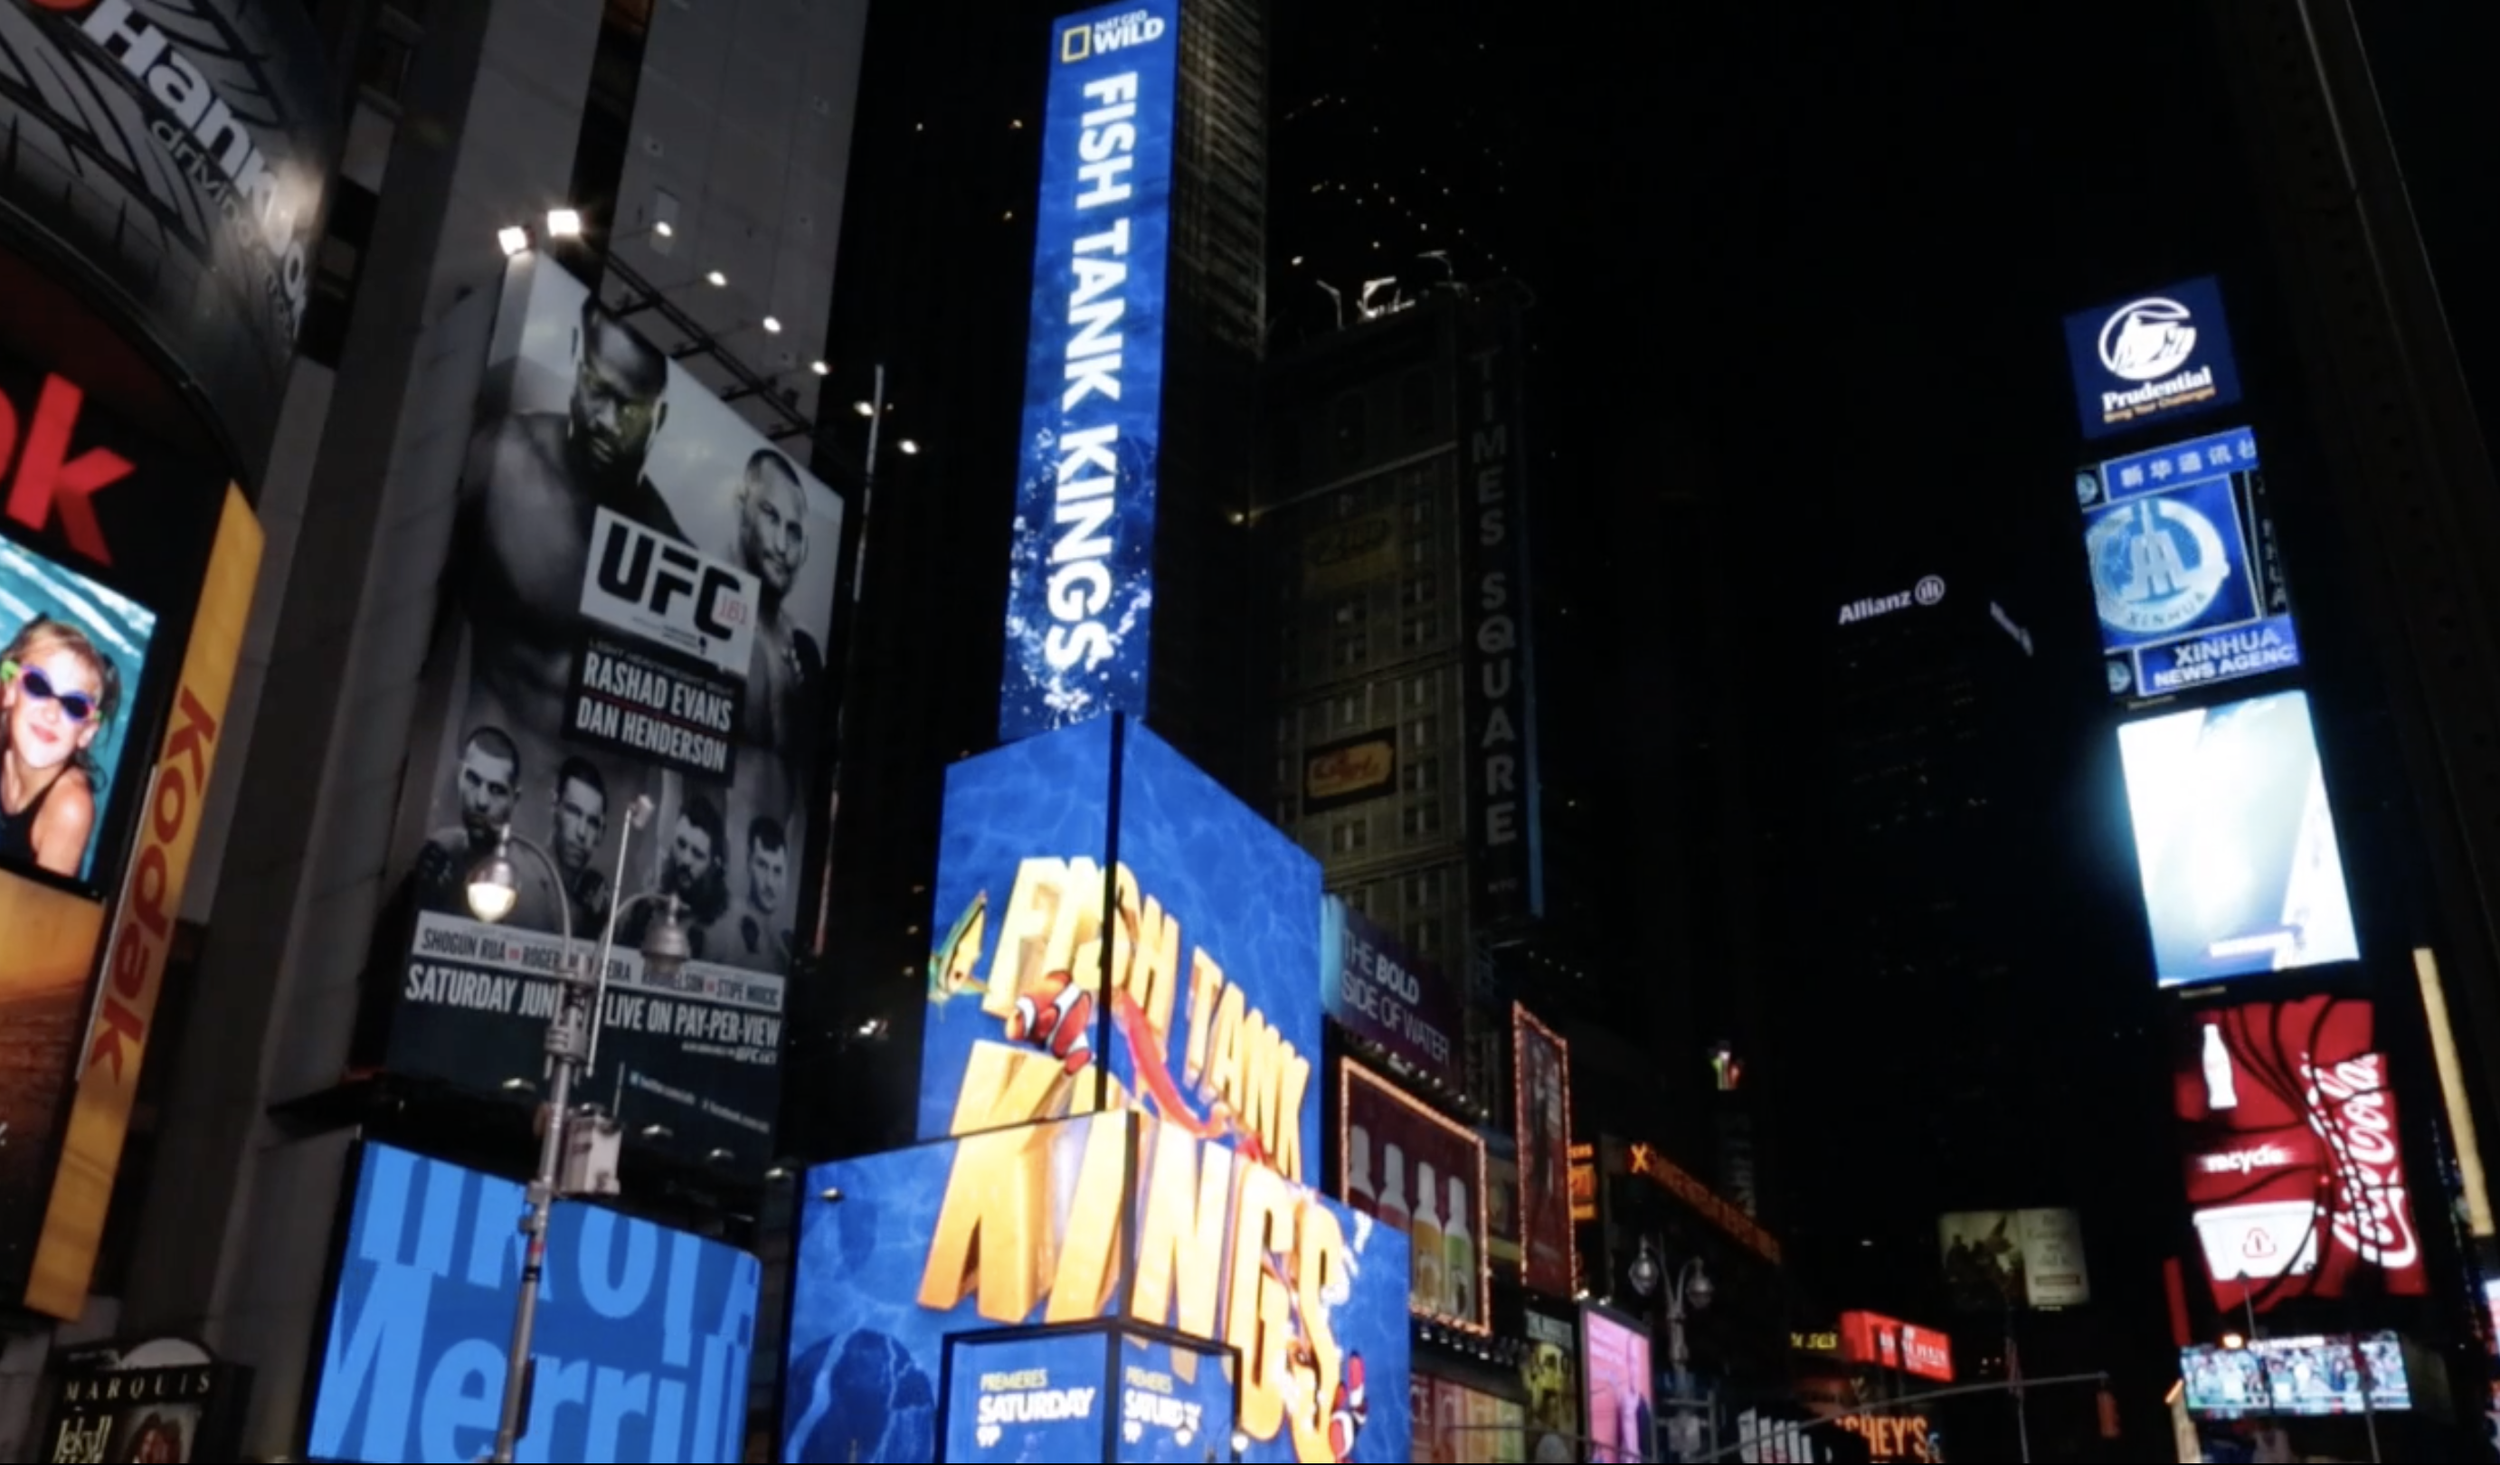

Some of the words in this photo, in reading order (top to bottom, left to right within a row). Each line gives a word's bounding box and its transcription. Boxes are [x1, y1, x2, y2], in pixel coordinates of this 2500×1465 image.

[1093, 16, 1165, 55] WILD
[1075, 70, 1138, 211] FISH
[1062, 217, 1130, 414] TANK
[2102, 365, 2214, 411] Prudential
[0, 371, 137, 568] k
[1470, 348, 1508, 548] TIMES
[597, 520, 742, 642] UFC
[1045, 422, 1118, 673] KINGS
[1838, 589, 1912, 626] Allianz
[2174, 627, 2282, 668] XINHUA
[582, 650, 668, 710] RASHAD
[670, 682, 733, 733] EVANS
[1476, 571, 1518, 847] SQUARE
[2152, 661, 2217, 688] NEWS
[575, 696, 620, 740] DAN
[621, 709, 728, 774] HENDERSON
[89, 685, 217, 1085] Kodak
[421, 928, 479, 960] SHOGUN
[479, 936, 506, 963] RUA
[1342, 928, 1374, 976] THE
[1375, 952, 1420, 1005] BOLD
[404, 963, 519, 1014] SATURDAY
[518, 980, 560, 1020] JUN
[604, 993, 643, 1031] LIVE
[646, 999, 673, 1035] ON
[674, 1003, 782, 1048] PAY-PER-VIEW
[981, 856, 1180, 1058] FISH
[1183, 945, 1310, 1184] TANK
[1341, 970, 1379, 1021] SIDE
[1380, 996, 1402, 1033] OF
[1403, 1010, 1449, 1068] WATER
[916, 1040, 1349, 1463] KINGS
[976, 1386, 1096, 1423] SATURDAY
